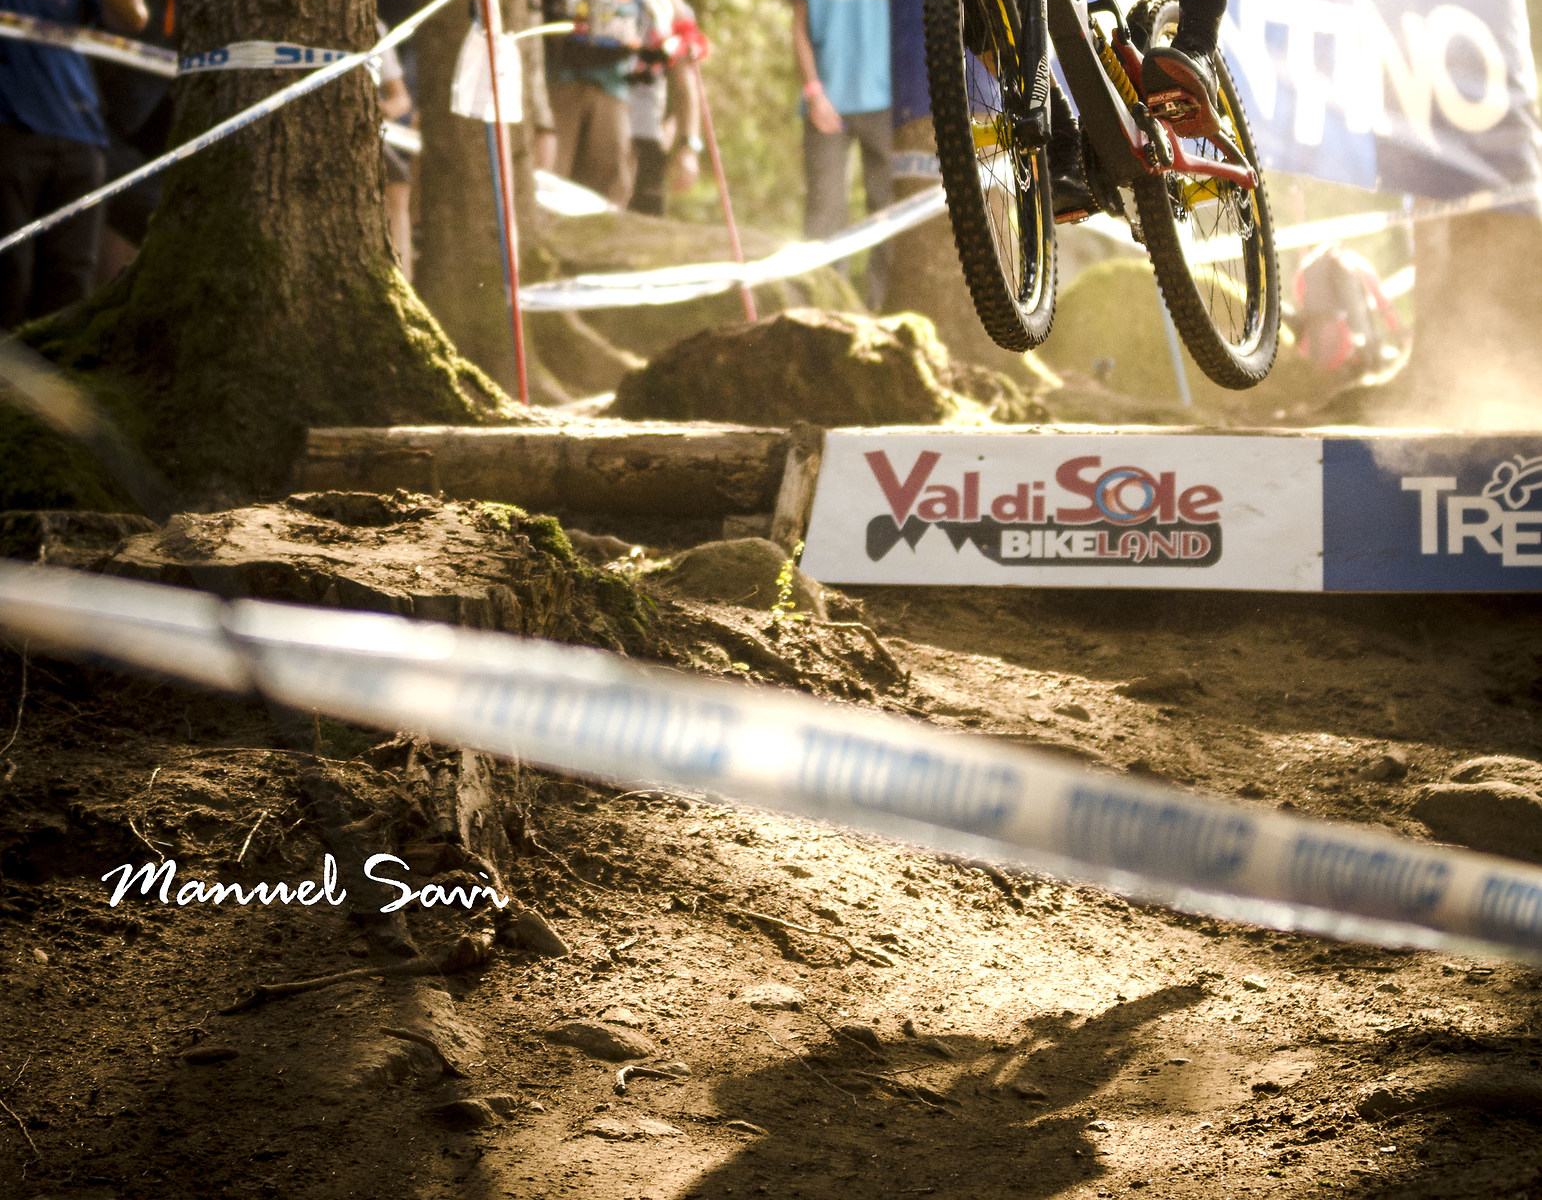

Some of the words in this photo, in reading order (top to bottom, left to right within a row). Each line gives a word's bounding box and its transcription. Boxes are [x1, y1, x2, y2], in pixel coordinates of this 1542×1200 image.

[863, 450, 980, 529] Val
[991, 480, 1046, 524] di
[1054, 455, 1224, 526] Sole
[1401, 476, 1542, 567] TRE
